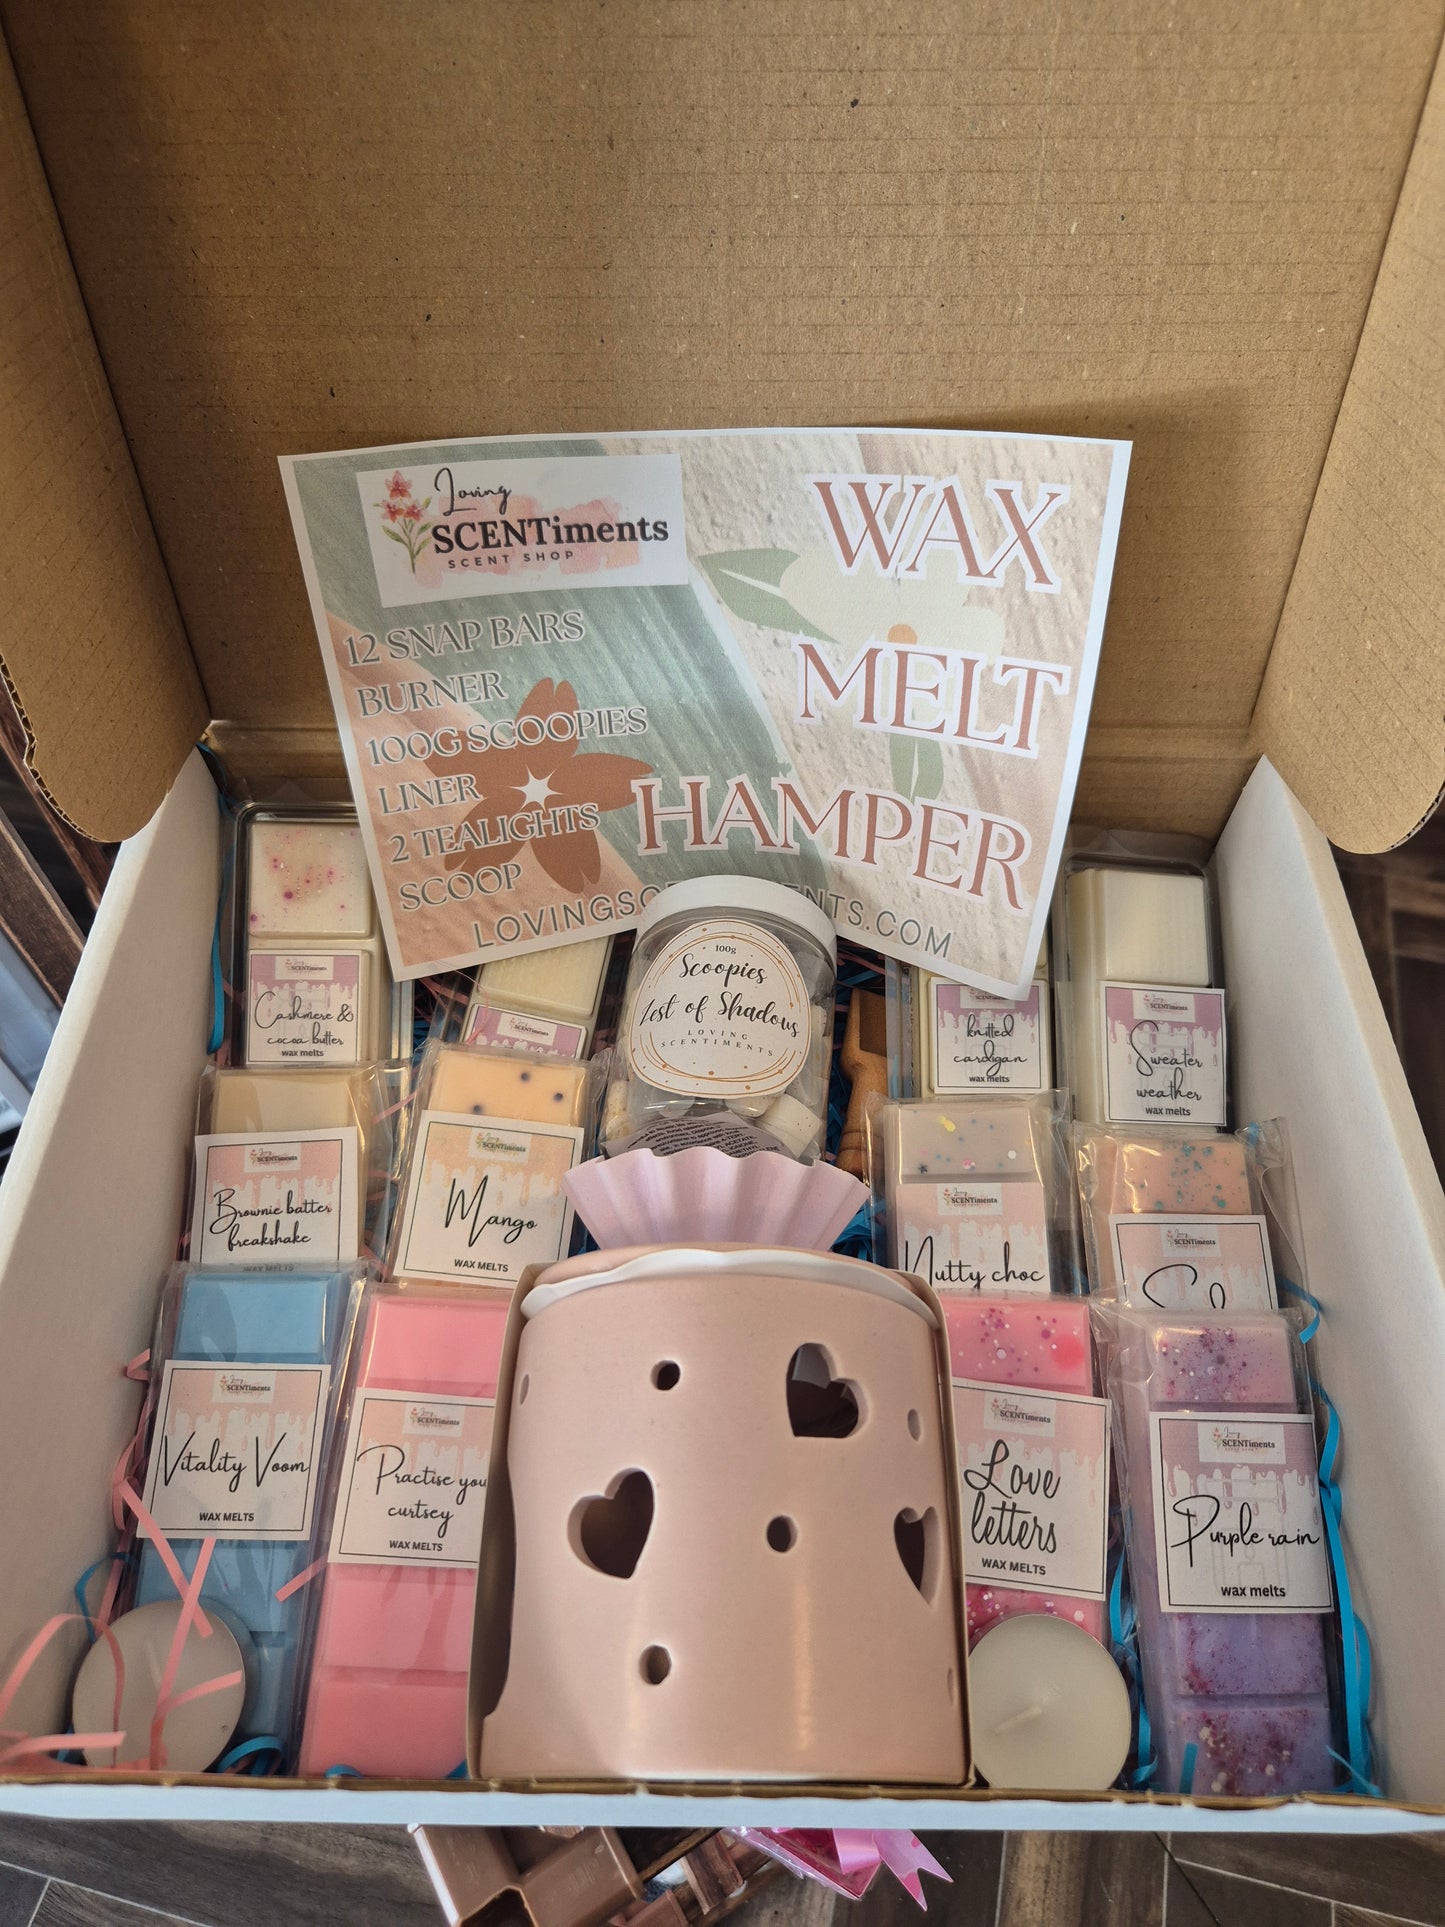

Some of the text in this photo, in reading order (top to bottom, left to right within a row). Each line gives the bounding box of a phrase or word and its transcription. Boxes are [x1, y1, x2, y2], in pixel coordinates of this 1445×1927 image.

[434, 467, 512, 516] Loving
[431, 516, 669, 554] SCENTiments
[811, 479, 1063, 588] WAX
[448, 550, 575, 569] SCENT SHOP
[344, 611, 585, 666] 12 SNAP BARS
[356, 671, 507, 717] BURNER
[798, 642, 1065, 752] MELT
[367, 707, 648, 766] 100G SCOOPIES
[378, 774, 483, 815] LINER
[389, 803, 600, 863] 2 TEALIGHTS
[636, 779, 1026, 912] HAMPER
[399, 863, 522, 911] SCOOP
[715, 945, 737, 955] 100g
[679, 953, 768, 988] Scoopies
[255, 991, 354, 1029] Cashmere &
[685, 995, 709, 1024] of
[967, 1013, 1015, 1038] knitted
[267, 1021, 344, 1046] cocoa butter
[661, 1038, 774, 1058] SCENTIMENTS
[688, 1029, 748, 1040] LOVING
[1130, 1020, 1203, 1077] Sweater
[300, 1049, 324, 1057] melts
[953, 1040, 1028, 1077] cardigan
[986, 1074, 1010, 1083] melts
[1136, 1067, 1202, 1101] weather
[1145, 1106, 1191, 1116] wax melts
[209, 1188, 333, 1235] Brownie batter
[445, 1174, 537, 1248] Mango
[228, 1219, 312, 1252] freakshake
[454, 1259, 509, 1273] WAX MELTS
[905, 1235, 1046, 1290] Nutty choc
[164, 1431, 310, 1493] Vitality Voom
[357, 1445, 487, 1505] Practise you
[964, 1439, 1061, 1499] Love
[200, 1512, 255, 1522] WAX MELTS
[388, 1499, 454, 1538] curtsey
[971, 1491, 1057, 1554] letters
[1170, 1494, 1320, 1568] Purple rain
[389, 1540, 443, 1552] WAX MELTS
[981, 1557, 1046, 1576] WAX MELTS
[1220, 1584, 1286, 1597] wax melts
